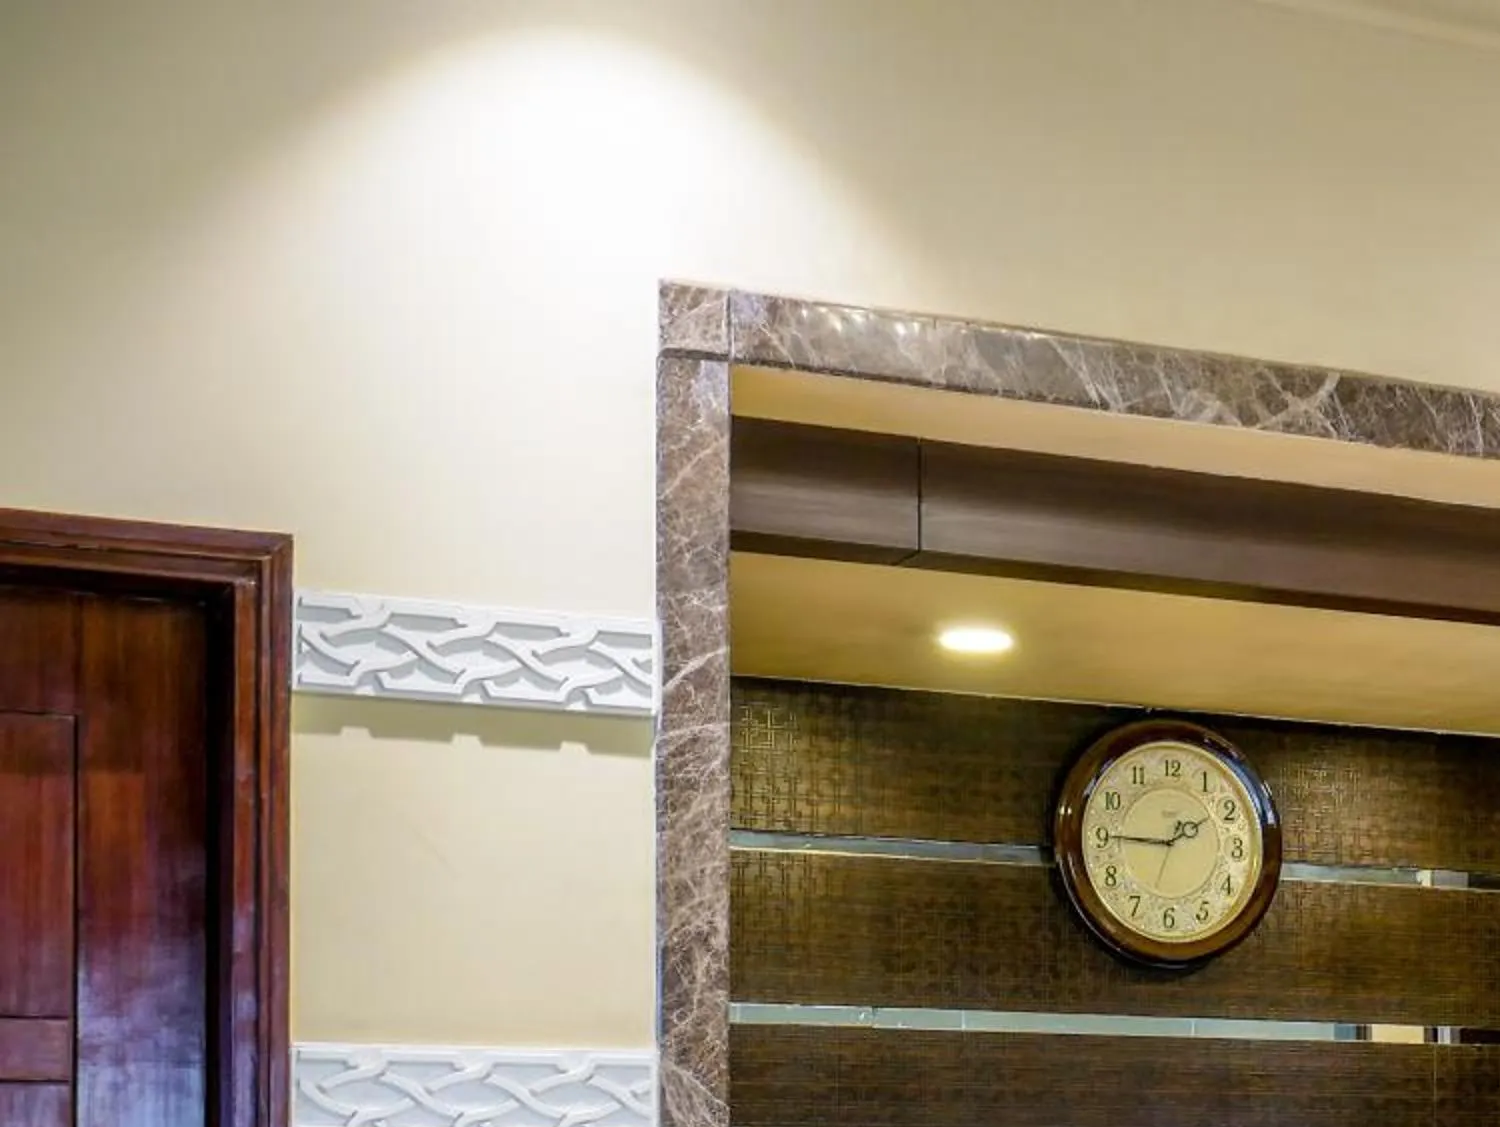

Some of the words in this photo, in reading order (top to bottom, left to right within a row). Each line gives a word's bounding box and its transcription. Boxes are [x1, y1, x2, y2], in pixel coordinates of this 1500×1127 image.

[1132, 767, 1145, 784] 11
[1164, 760, 1181, 777] 12
[1202, 771, 1207, 792] 1
[1105, 792, 1120, 810] 10
[1224, 800, 1234, 821] 2
[1097, 829, 1109, 848] 9
[1232, 839, 1243, 858] 3
[1105, 866, 1117, 886] 8
[1221, 876, 1231, 896] 4
[1129, 896, 1140, 917] 7
[1196, 902, 1209, 921] 5
[1164, 908, 1175, 929] 6
